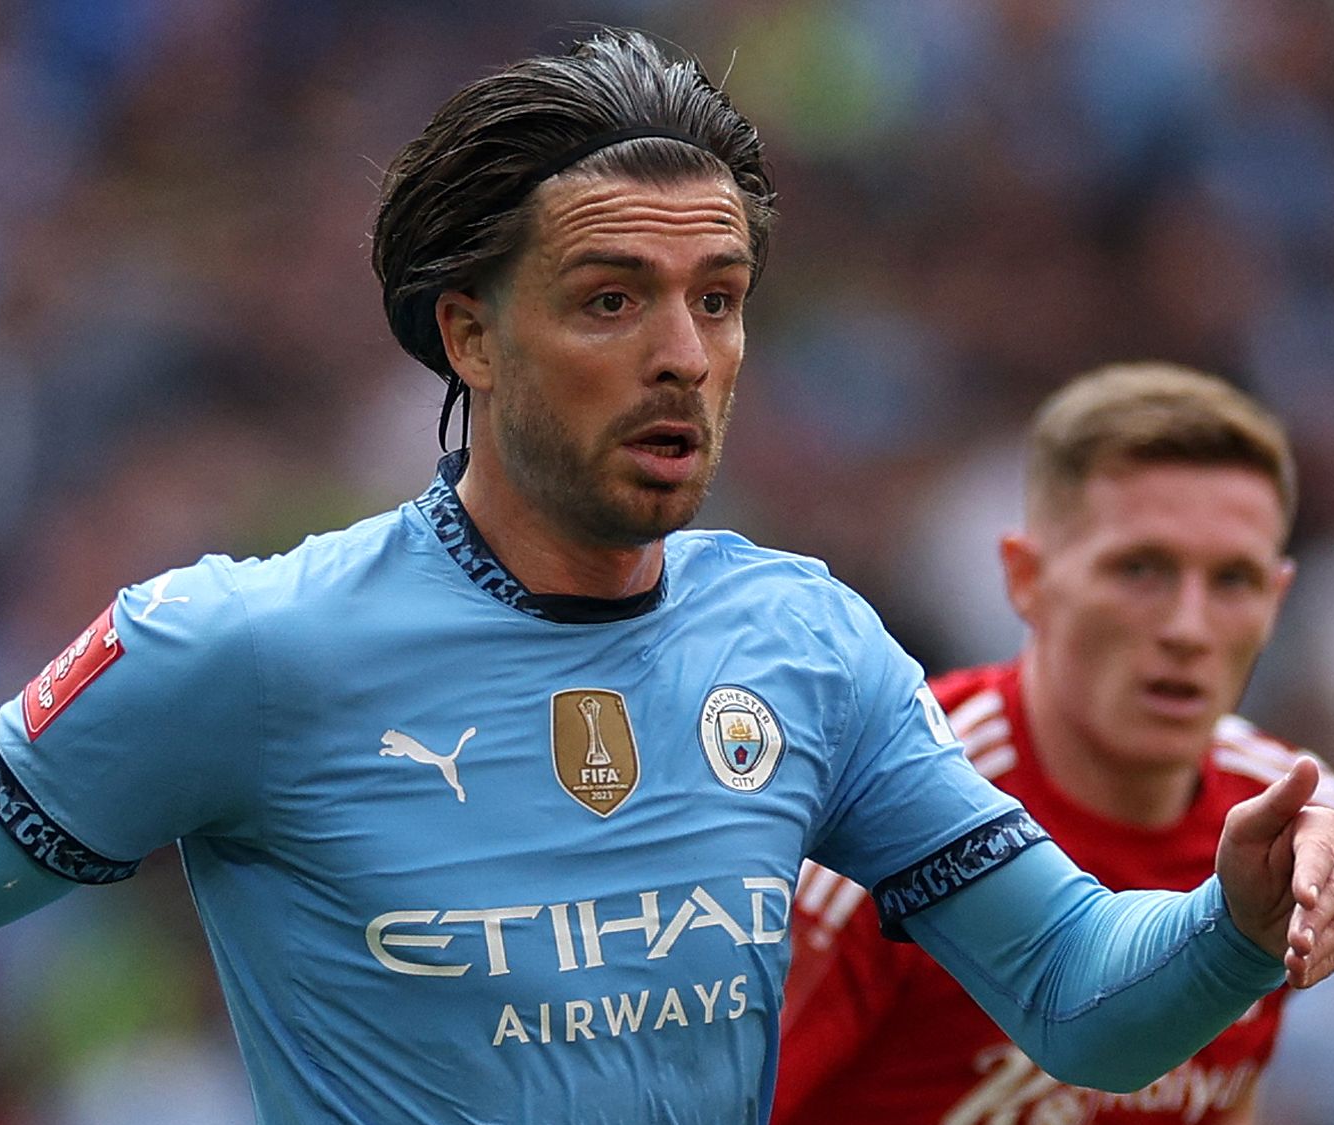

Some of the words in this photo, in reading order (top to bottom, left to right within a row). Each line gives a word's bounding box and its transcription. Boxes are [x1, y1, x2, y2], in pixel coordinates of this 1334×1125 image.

[38, 675, 54, 709] CUP
[705, 691, 771, 724] MANCHESTER
[581, 768, 619, 783] FIFA
[731, 777, 755, 789] CITY
[365, 876, 791, 977] ETIHAD
[492, 974, 748, 1046] AIRWAYS
